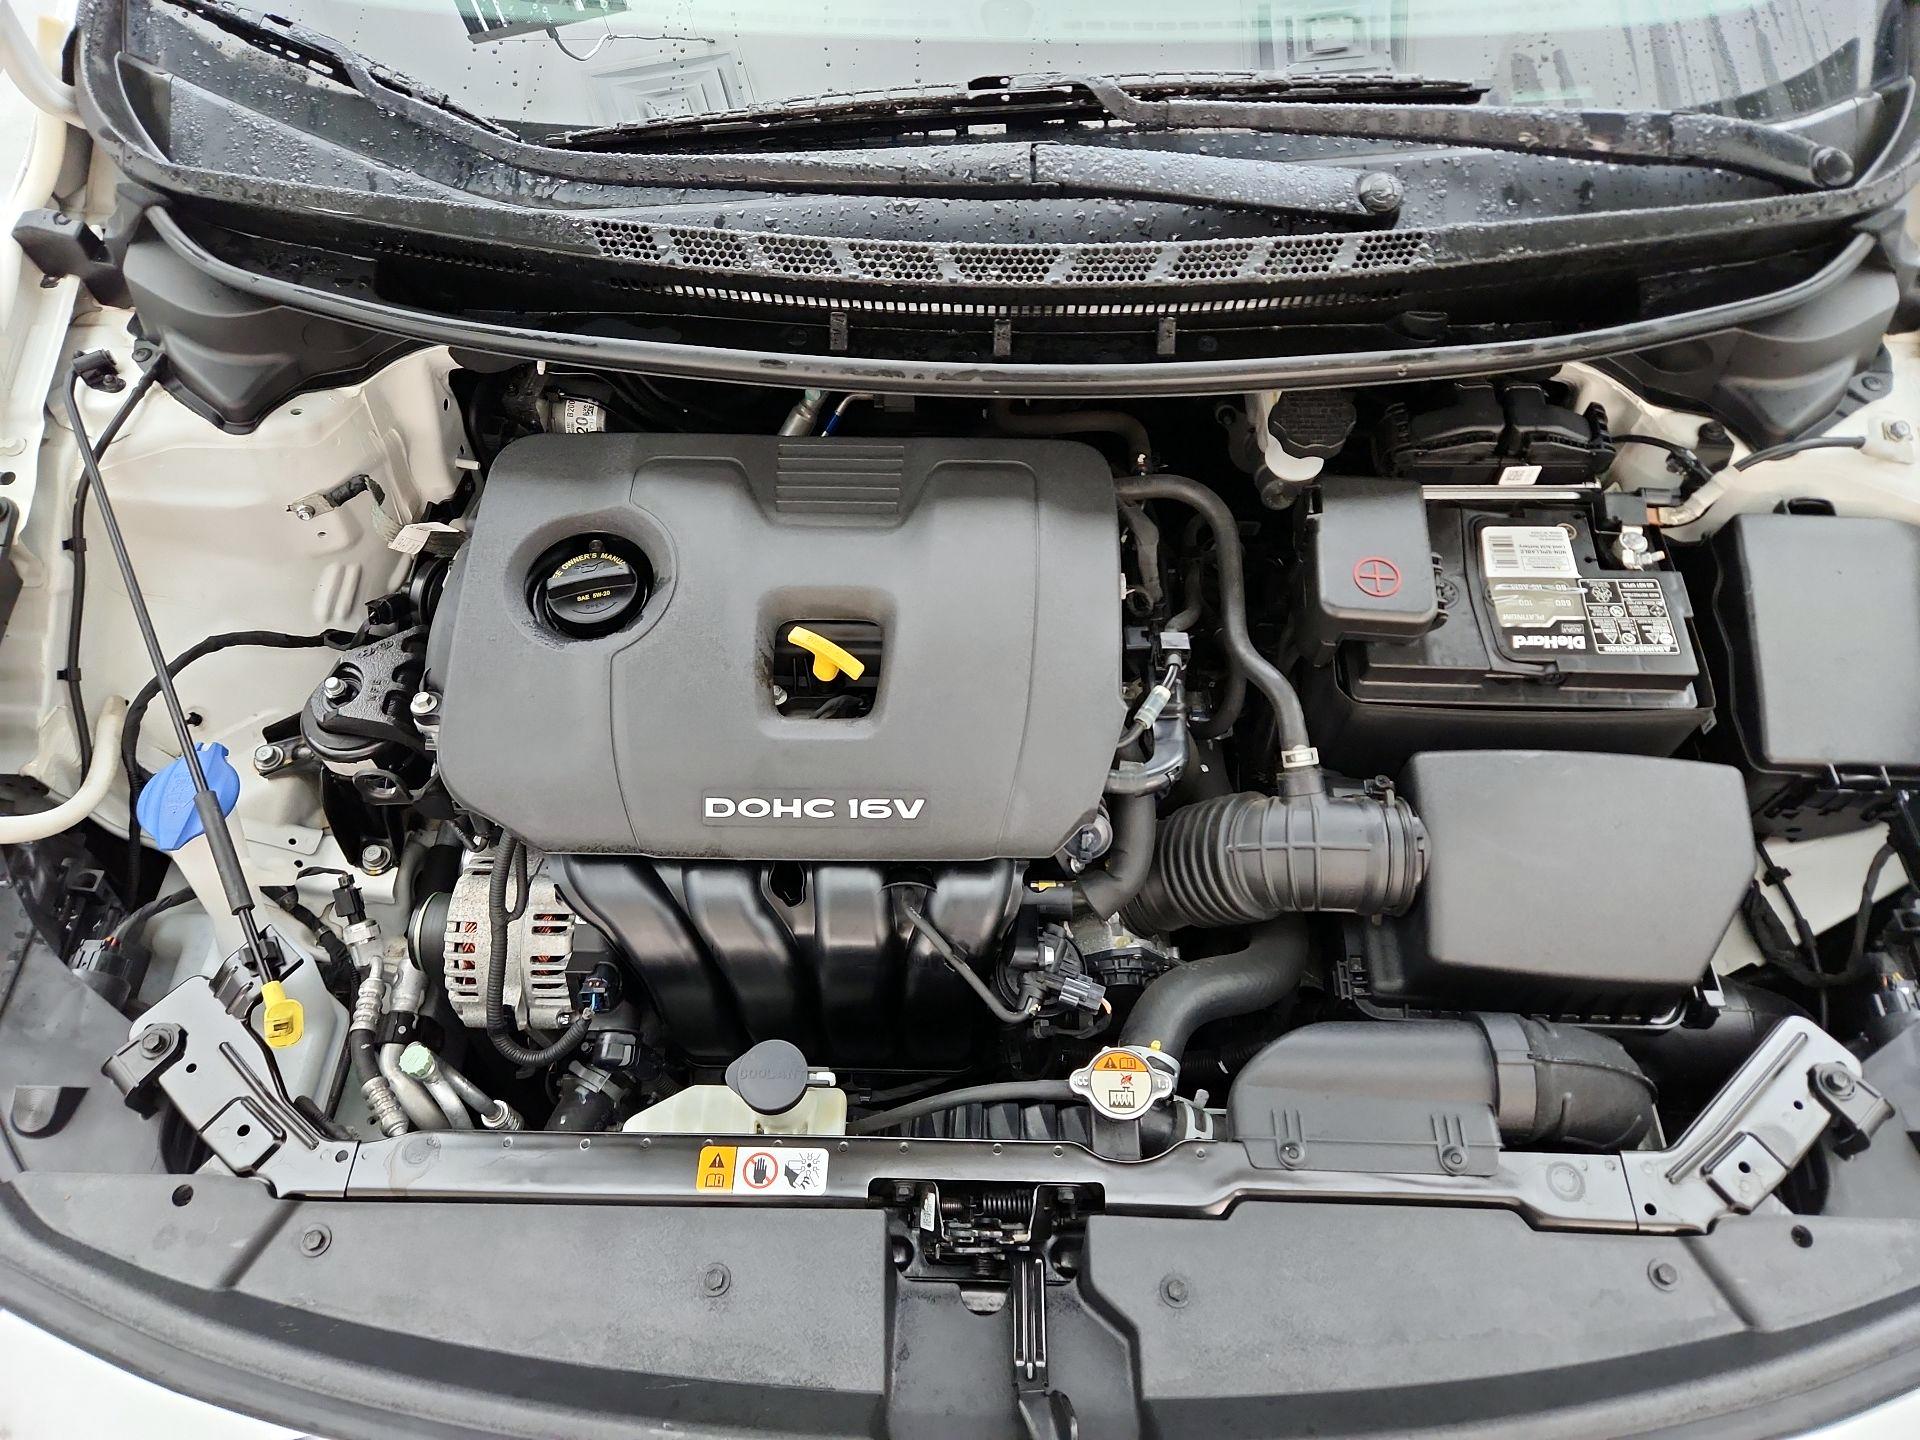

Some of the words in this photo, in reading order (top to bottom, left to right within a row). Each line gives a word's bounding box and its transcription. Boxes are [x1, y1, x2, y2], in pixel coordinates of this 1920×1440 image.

[561, 552, 598, 570] OWNER'S
[576, 594, 590, 602] SAE
[1503, 613, 1545, 621] PLATINUM
[1512, 635, 1587, 650] DieHard
[705, 797, 836, 819] DOHC
[848, 798, 926, 820] 16V
[739, 1068, 806, 1081] COOLANT
